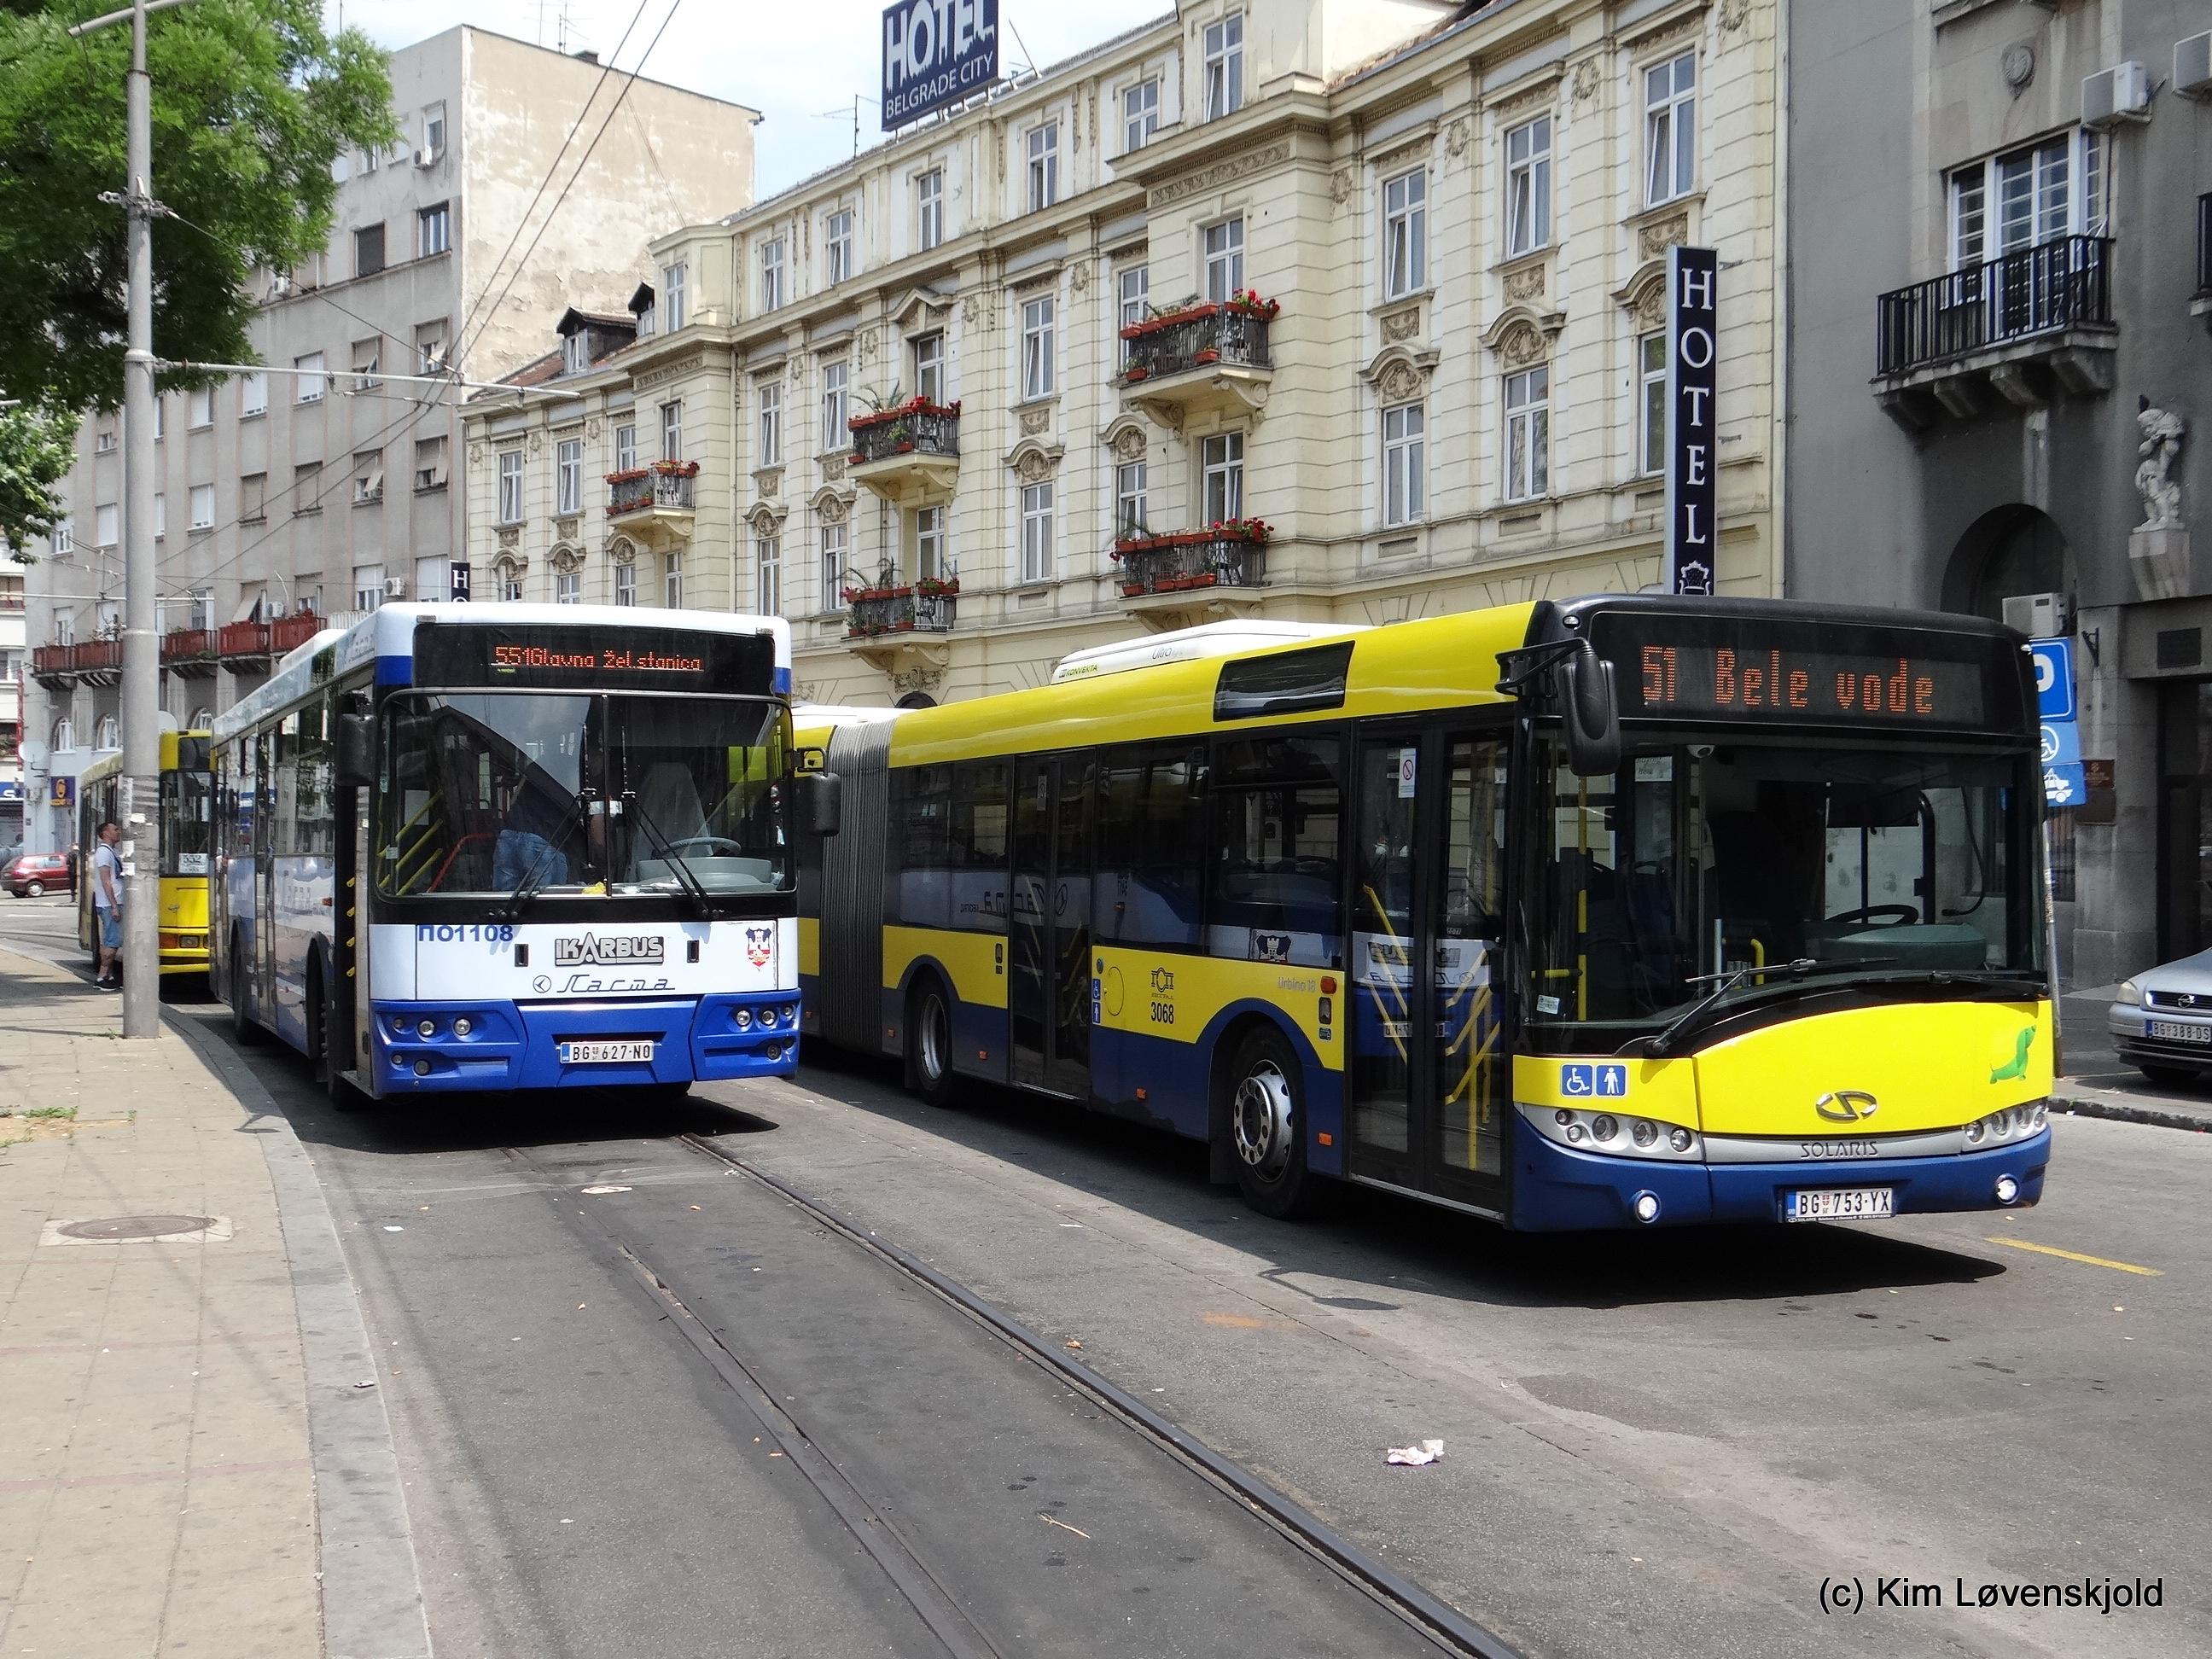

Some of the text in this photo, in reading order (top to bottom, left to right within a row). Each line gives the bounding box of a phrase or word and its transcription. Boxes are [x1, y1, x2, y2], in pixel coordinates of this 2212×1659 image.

[886, 0, 995, 94] HOTEL
[886, 50, 994, 120] BELGRADE CITY
[1680, 267, 1714, 544] HOTEL
[1066, 664, 1098, 677] KONVEKTA
[1642, 646, 1934, 713] 51 Bele vode
[555, 931, 664, 966] IKARBUS
[1278, 976, 1306, 992] Urbino
[1150, 1001, 1174, 1024] 3068
[2154, 1023, 2165, 1035] BG
[573, 1046, 590, 1061] BG
[1800, 1141, 1878, 1158] SOLARIS
[1800, 1194, 1819, 1214] BG
